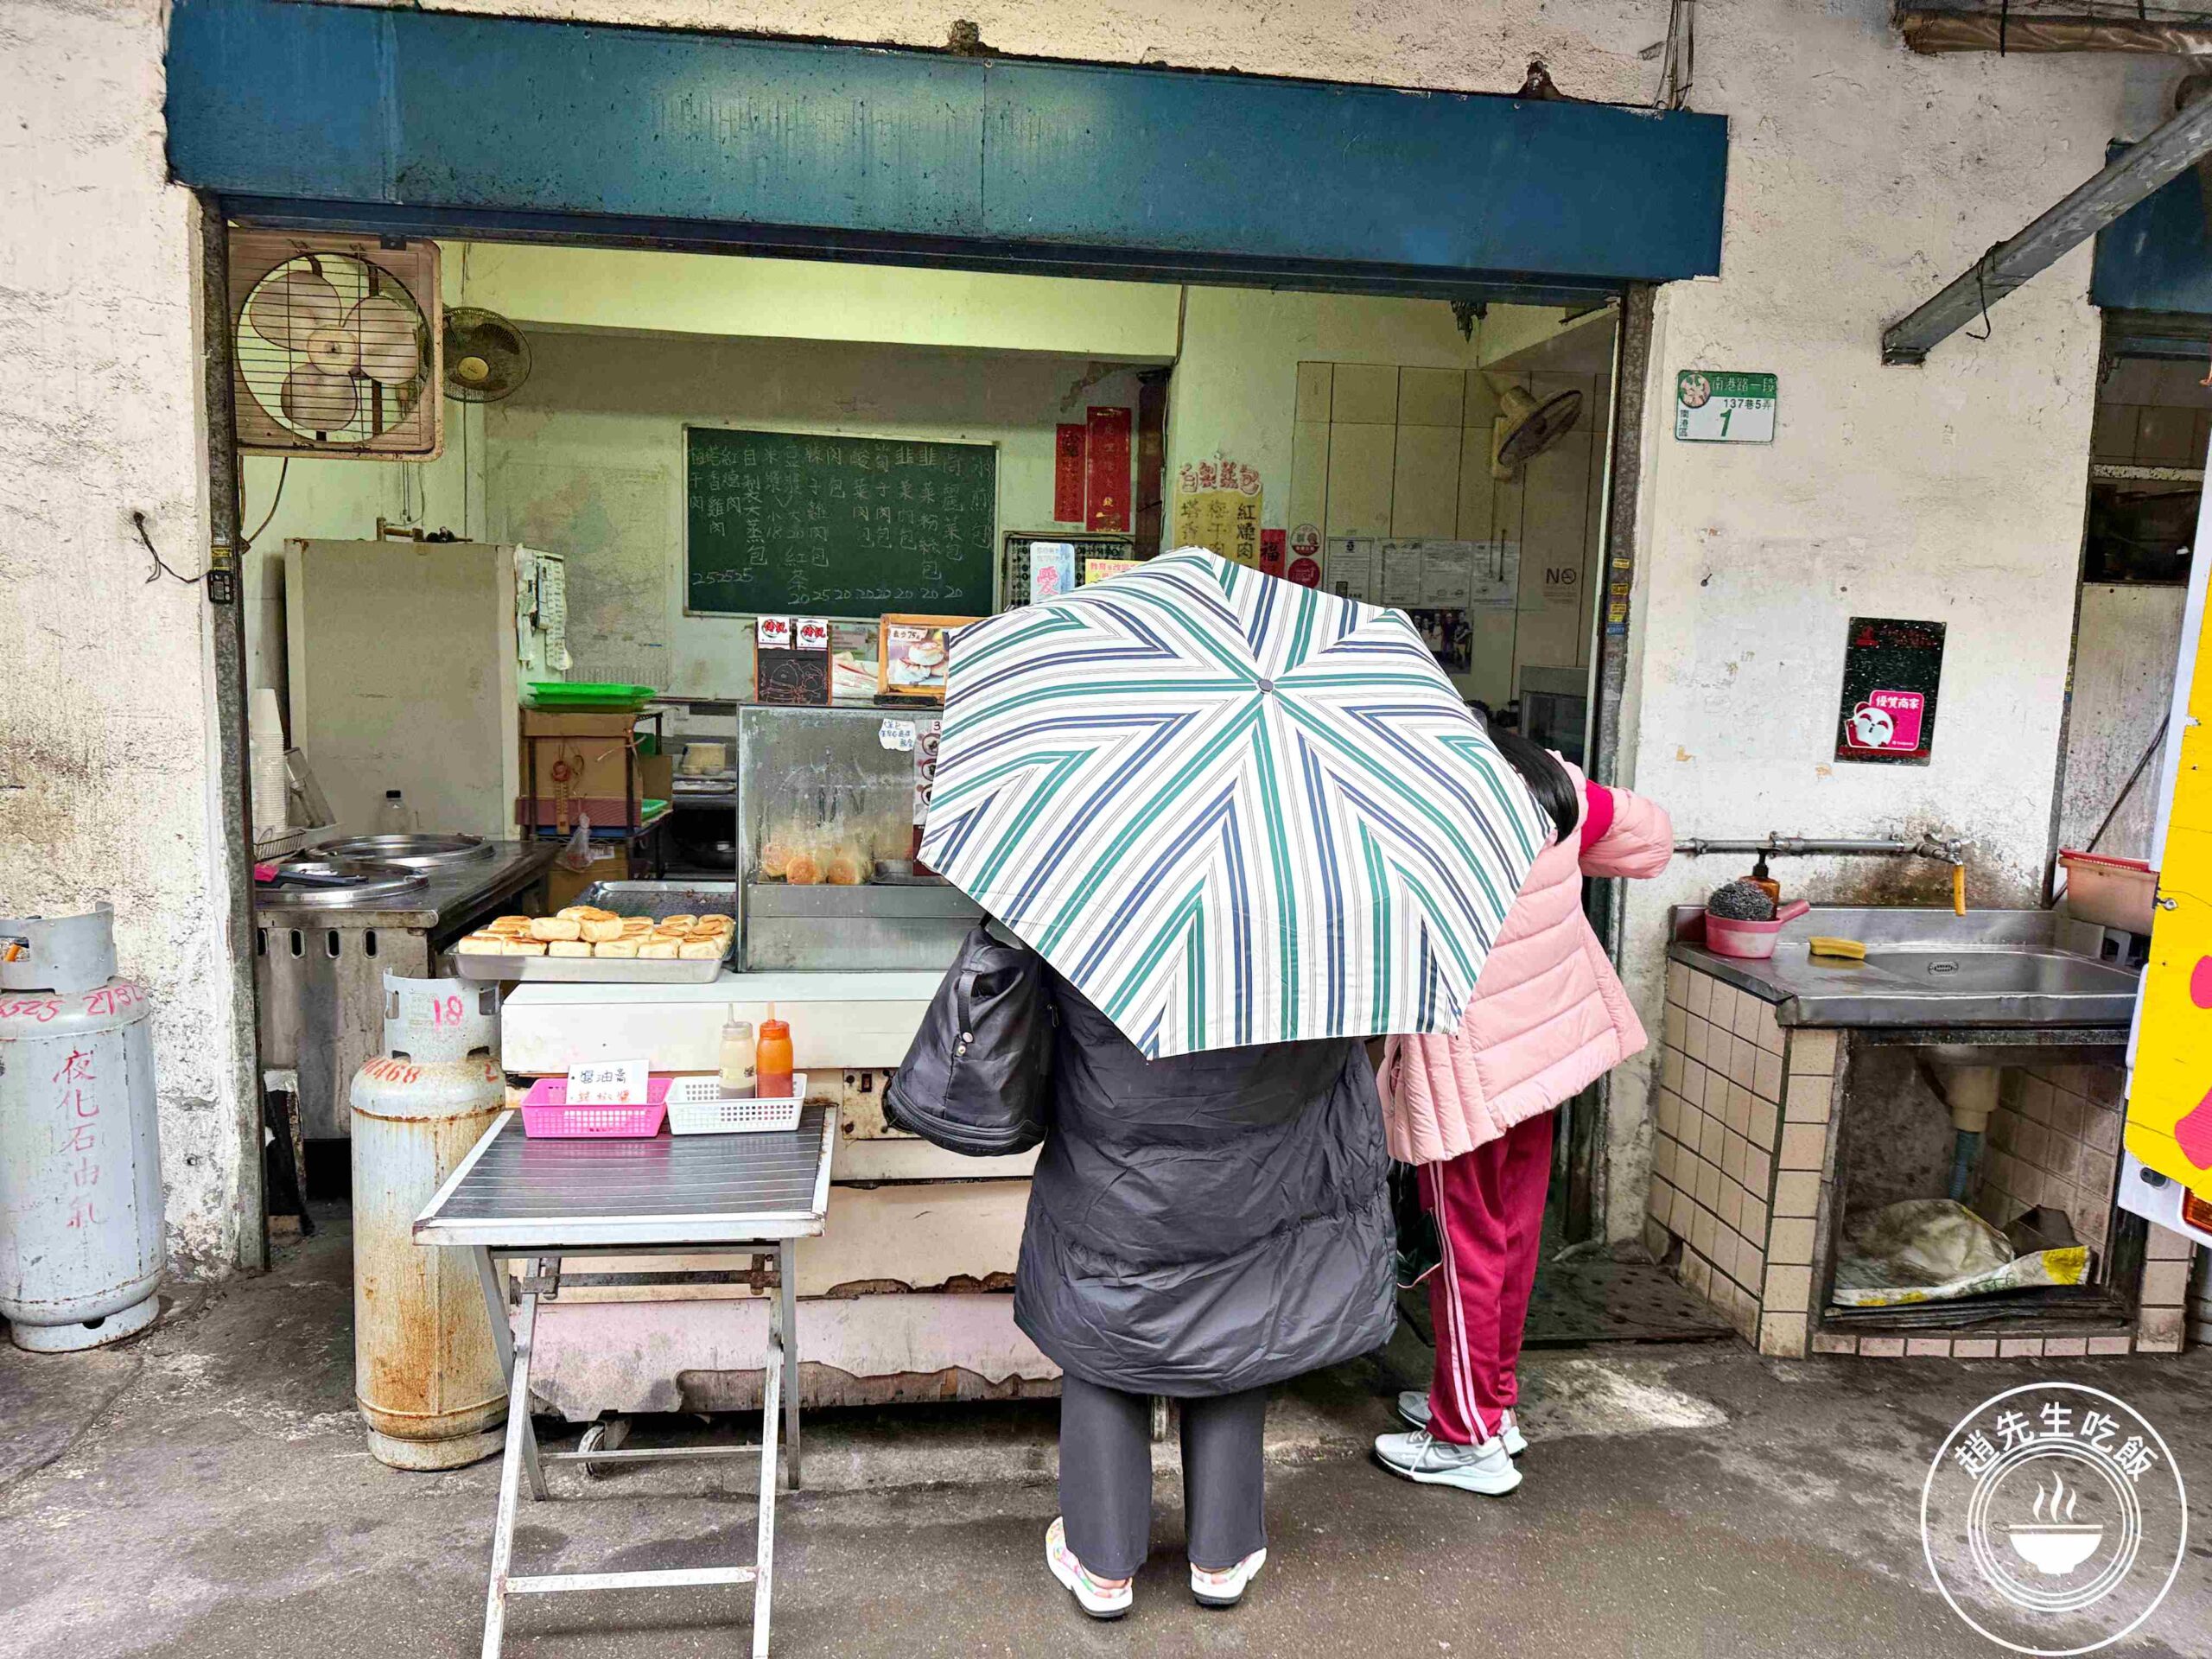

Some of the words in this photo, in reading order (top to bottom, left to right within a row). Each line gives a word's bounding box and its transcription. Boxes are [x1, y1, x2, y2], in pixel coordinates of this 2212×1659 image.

[1712, 376, 1776, 393] 南港路一段
[1724, 398, 1771, 410] 137巷5弄
[1679, 410, 1689, 437] 南港區
[1719, 409, 1732, 437] 1
[826, 446, 846, 499] 肉包
[1179, 461, 1261, 495] 自製蒸包
[1180, 499, 1203, 549] 塔香
[1876, 695, 1920, 710] 優質商家
[433, 995, 464, 1032] 18
